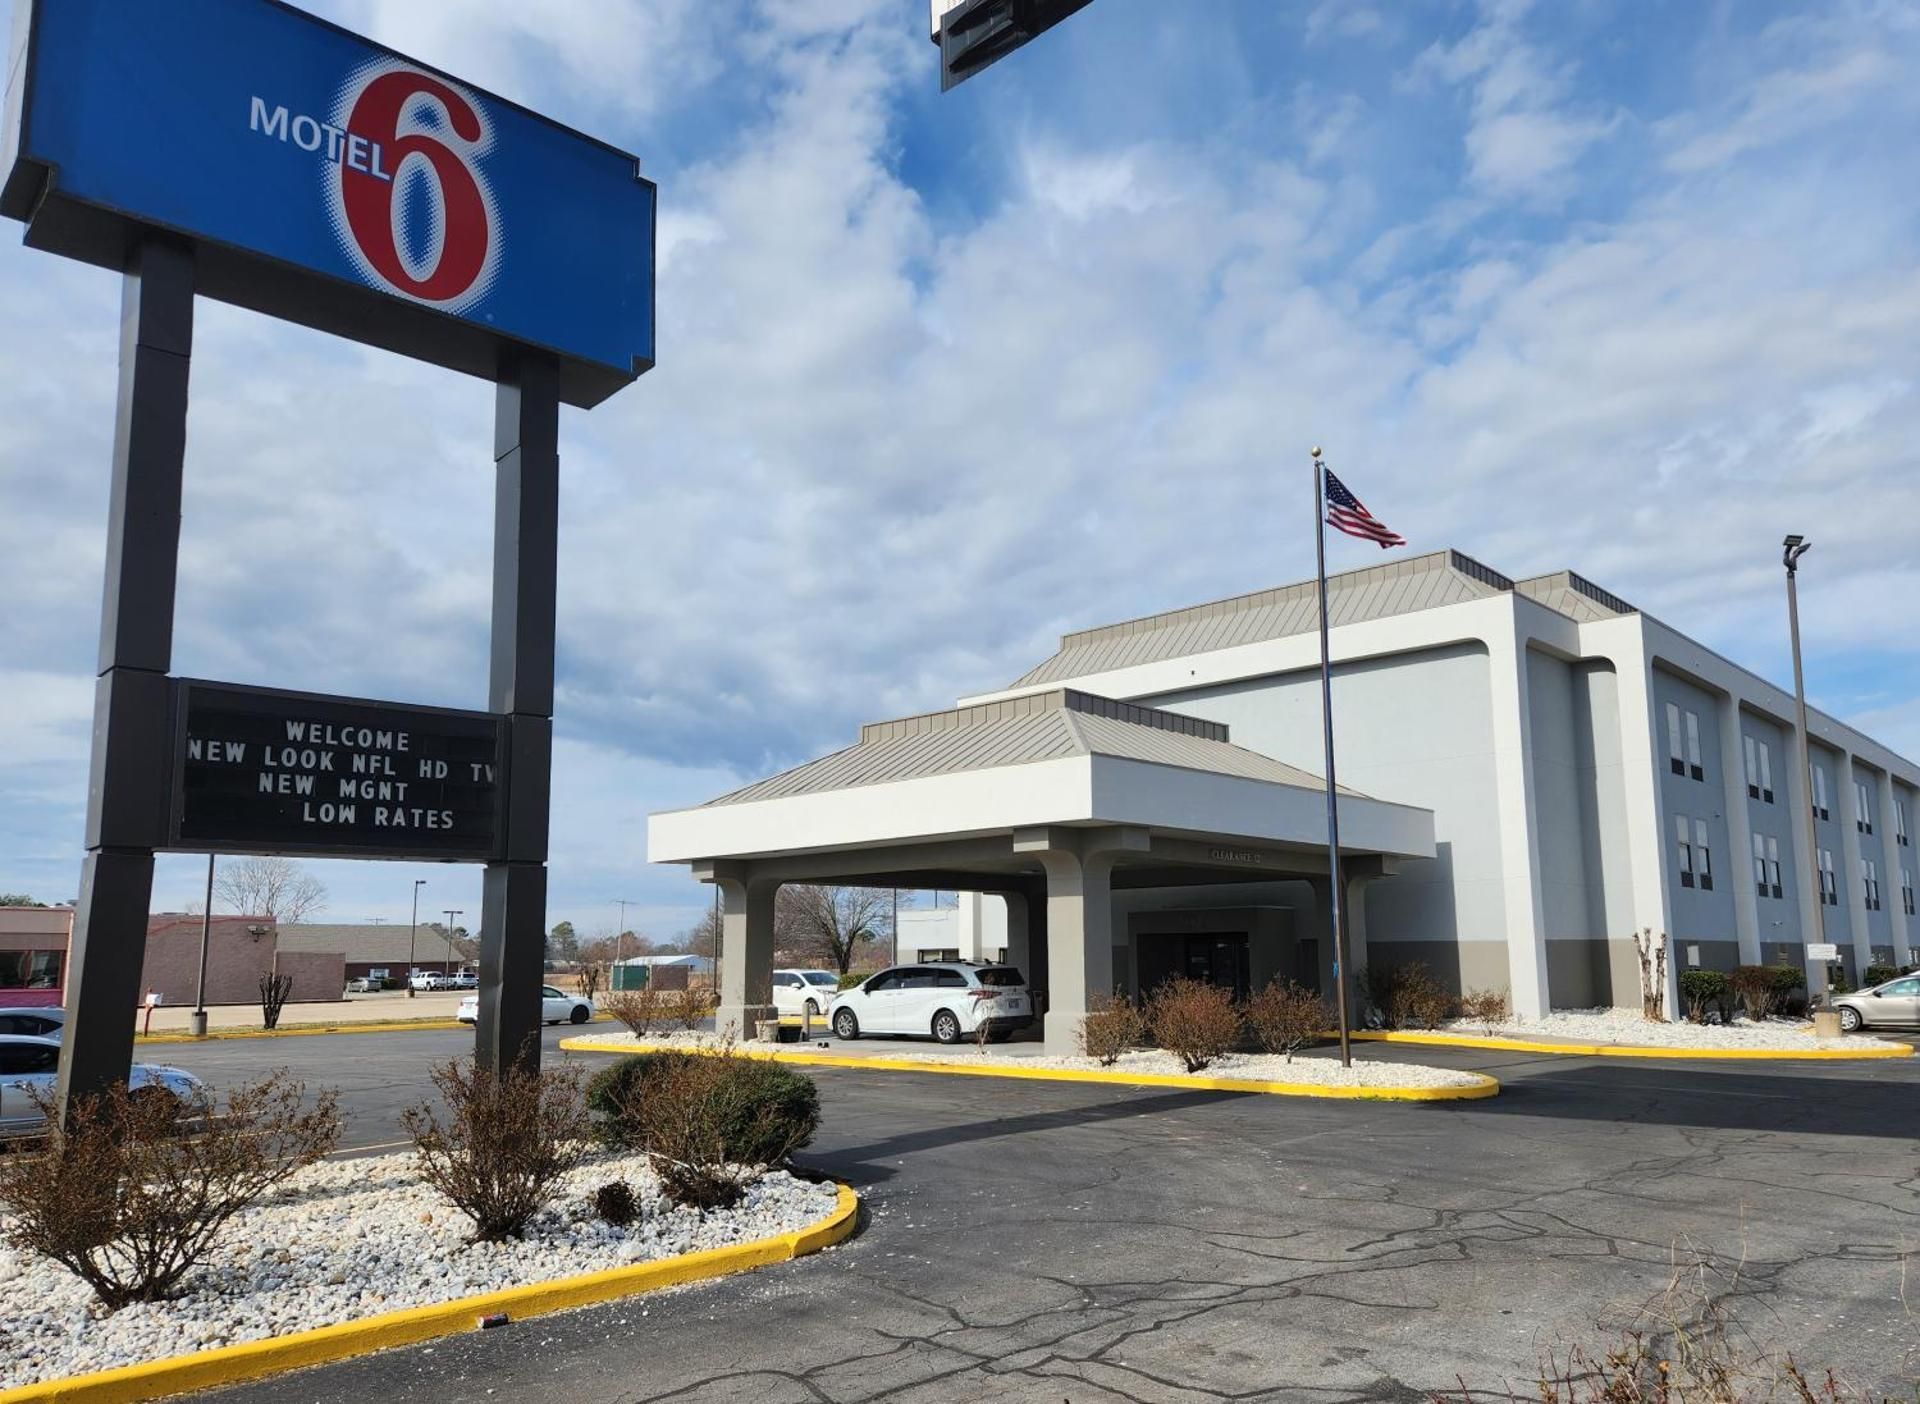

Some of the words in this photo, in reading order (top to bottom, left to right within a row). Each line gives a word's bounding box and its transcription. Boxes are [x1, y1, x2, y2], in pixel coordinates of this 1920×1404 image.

[250, 96, 391, 181] MOTEL
[341, 71, 488, 301] 6
[286, 720, 409, 751] WELCOME
[187, 739, 246, 763] NEW
[264, 746, 334, 771] LOOK
[352, 753, 396, 776] NFL
[419, 759, 448, 779] HD
[470, 763, 496, 783] TV
[259, 772, 314, 795] NEW
[339, 778, 408, 801] MGNT
[303, 802, 356, 824] LOW
[374, 806, 453, 829] RATES
